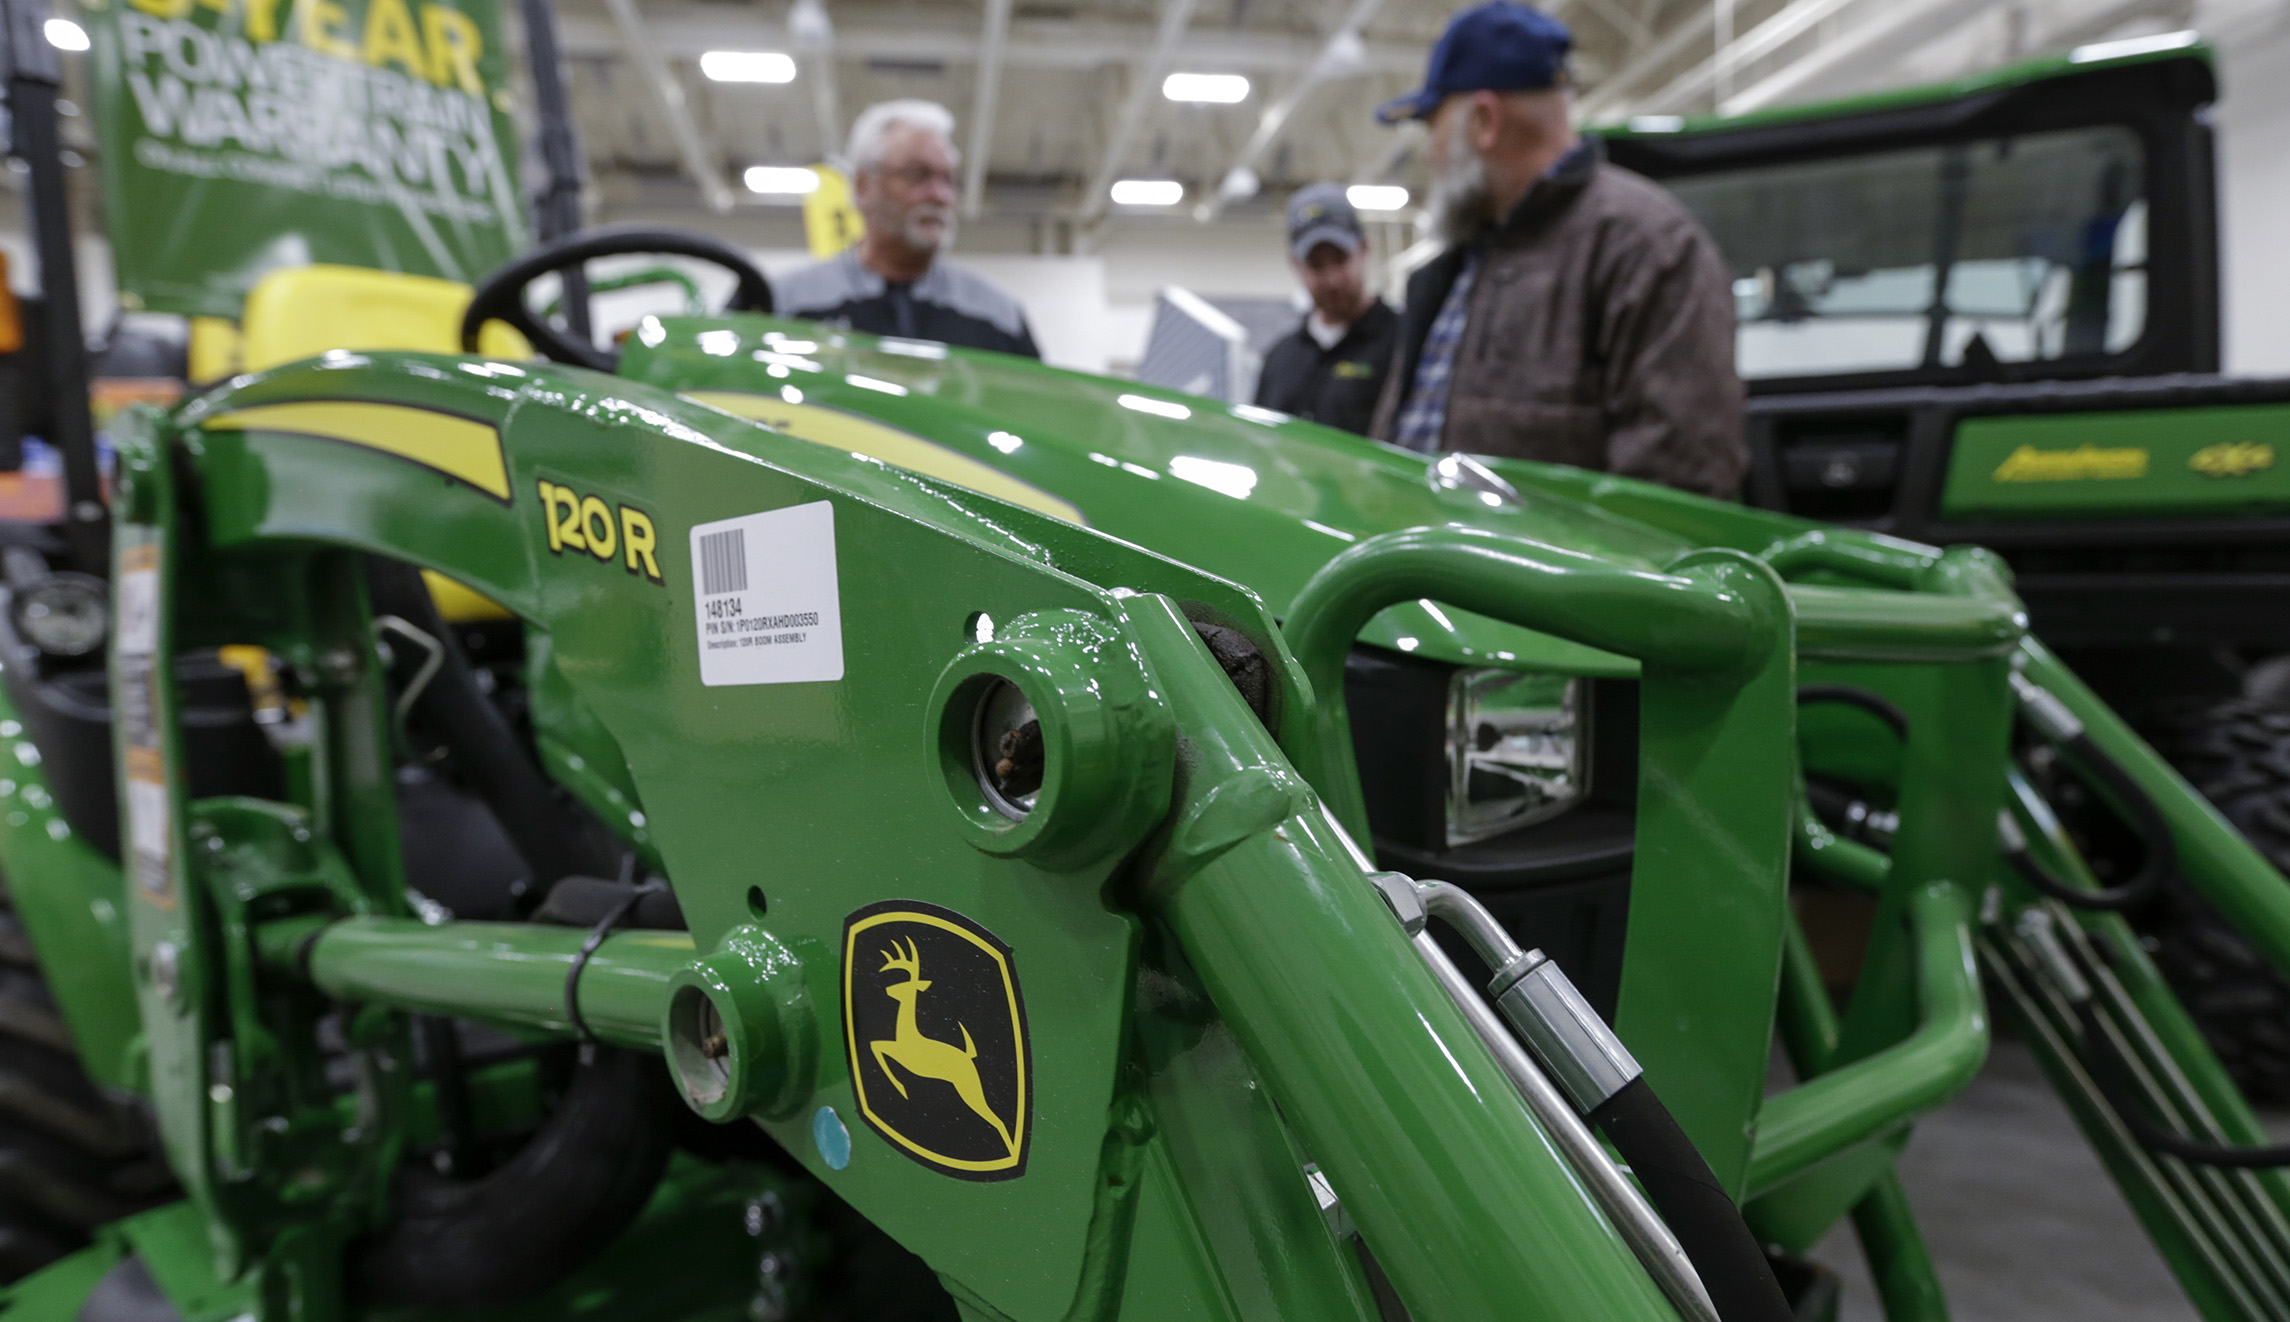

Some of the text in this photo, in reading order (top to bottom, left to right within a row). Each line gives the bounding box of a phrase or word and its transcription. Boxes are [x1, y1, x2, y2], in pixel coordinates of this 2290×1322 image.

[704, 597, 743, 619] 148134
[705, 621, 719, 635] PIN
[754, 634, 772, 646] BOOM
[773, 632, 807, 645] ASSEMBLY
